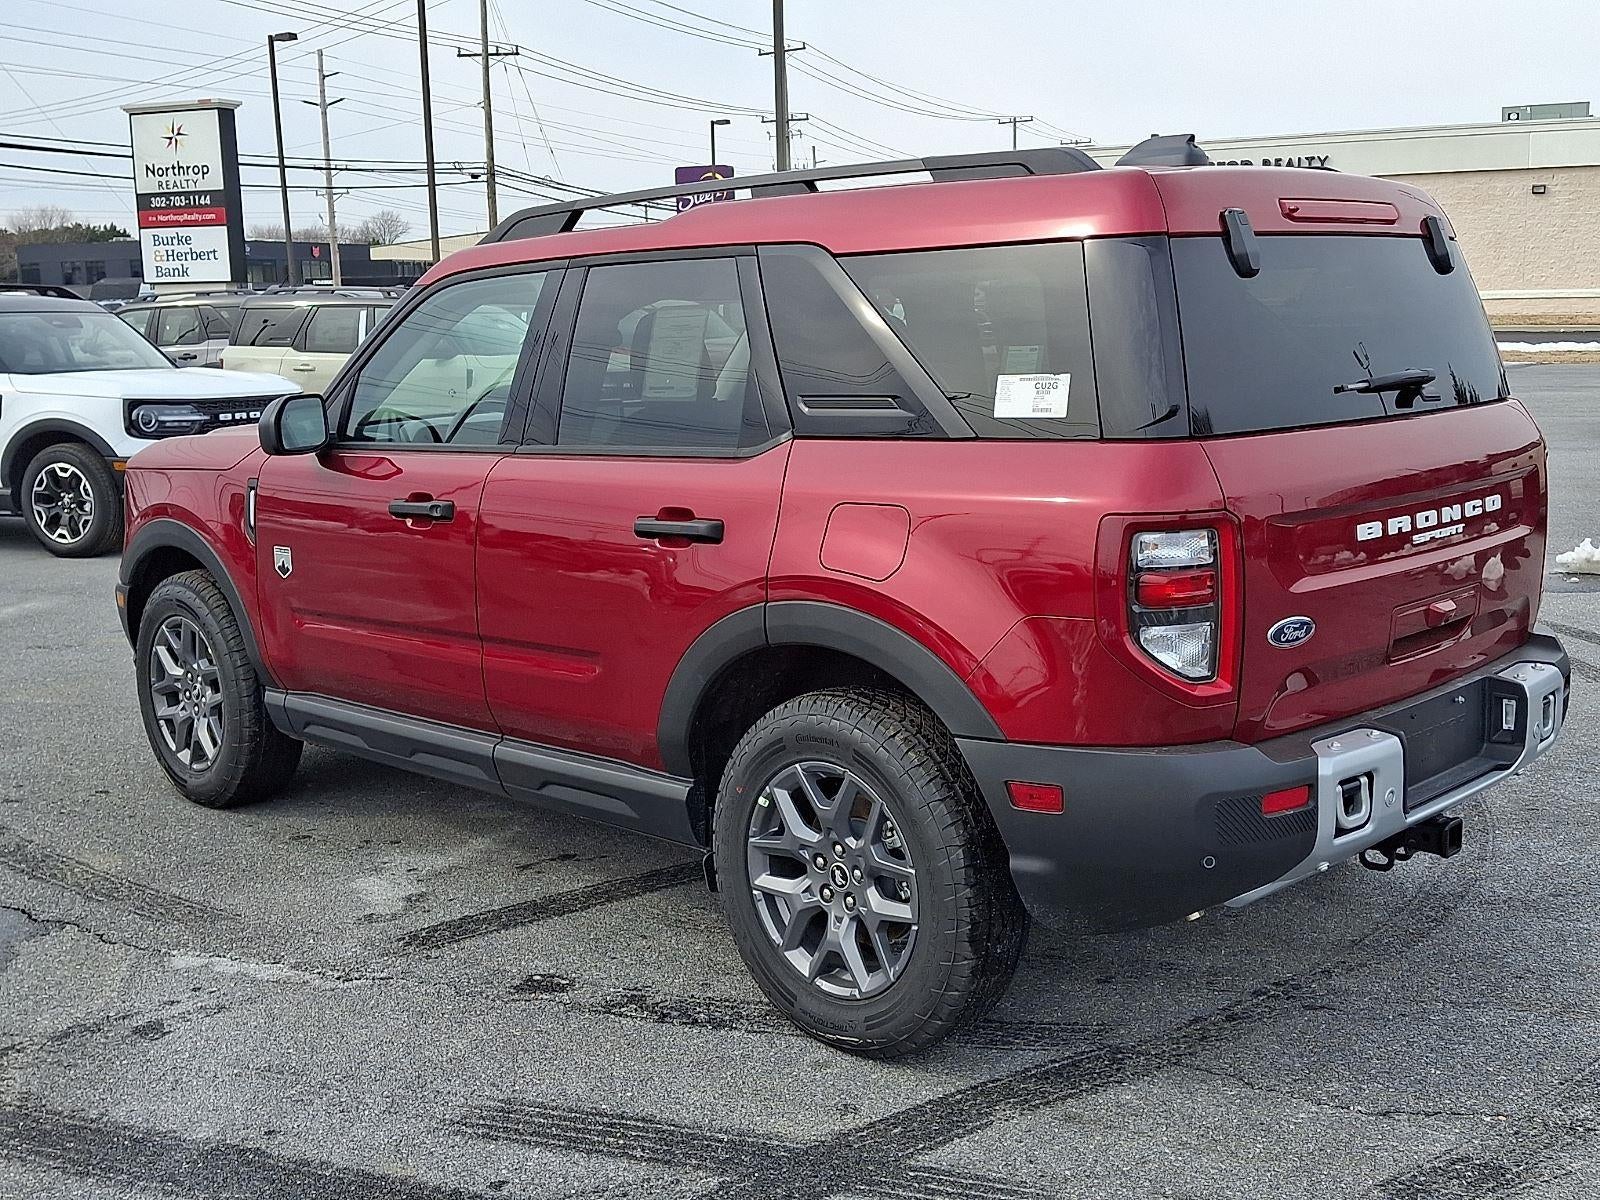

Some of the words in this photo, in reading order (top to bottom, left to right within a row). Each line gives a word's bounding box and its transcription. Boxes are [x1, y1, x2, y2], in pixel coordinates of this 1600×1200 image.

[145, 160, 210, 180] Northrop
[157, 178, 199, 191] REALTY
[150, 194, 211, 208] 302-703-1144
[151, 231, 193, 247] Burke
[154, 263, 190, 278] Bank
[1034, 381, 1059, 390] CU2G
[1356, 493, 1502, 542] BRONCO
[1411, 523, 1466, 545] SPORT
[1280, 623, 1308, 642] Ford
[795, 733, 834, 747] Continental
